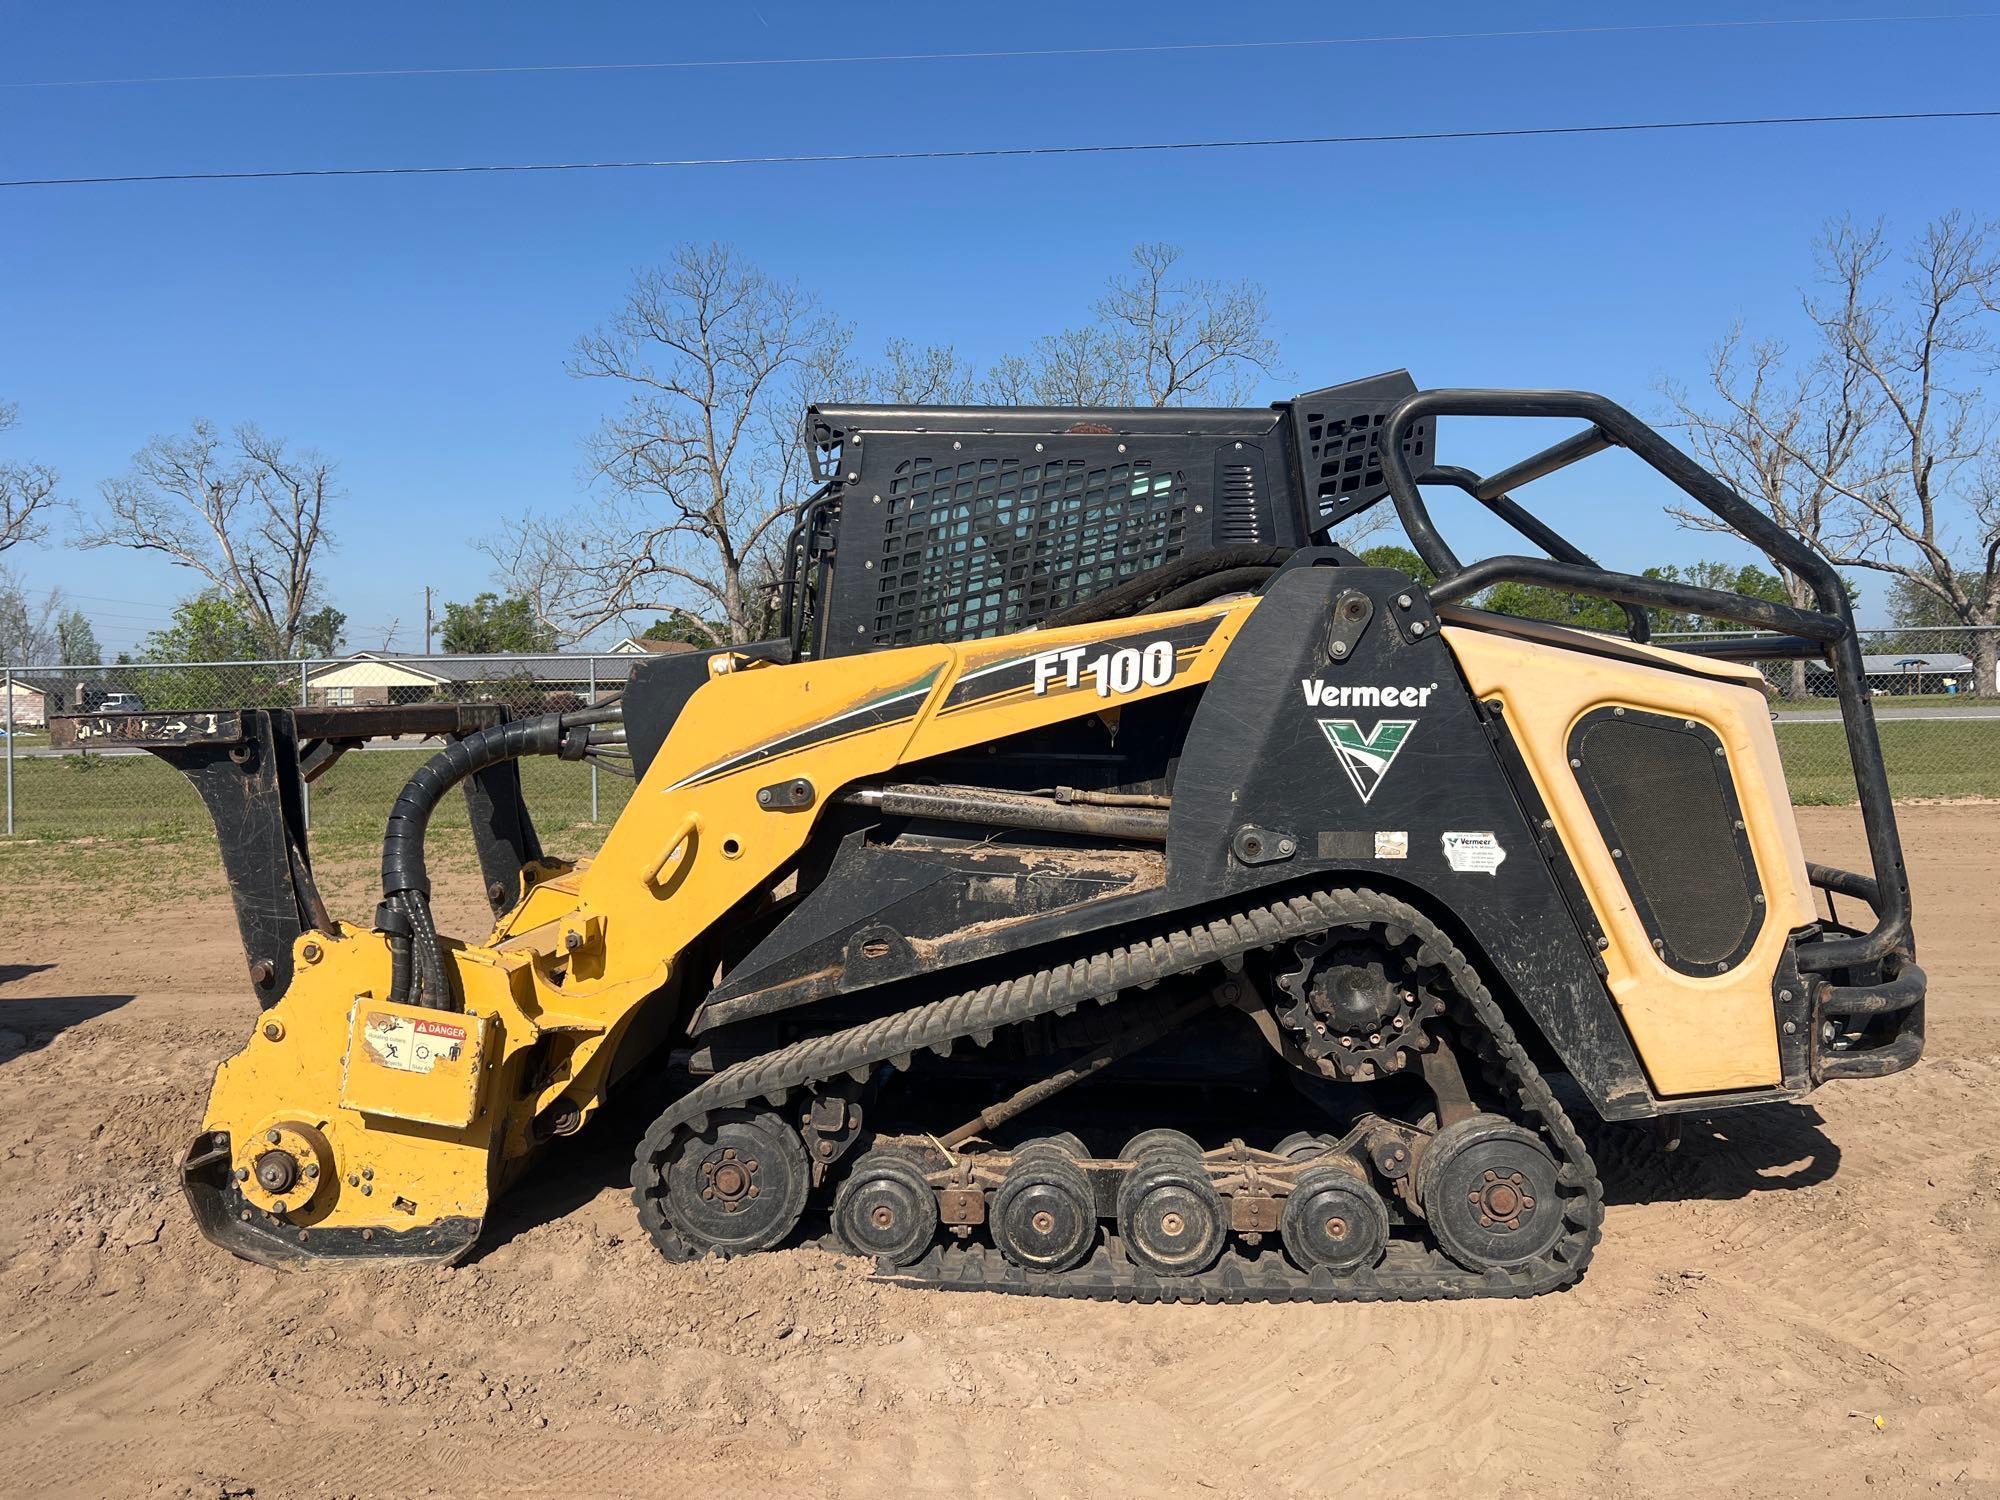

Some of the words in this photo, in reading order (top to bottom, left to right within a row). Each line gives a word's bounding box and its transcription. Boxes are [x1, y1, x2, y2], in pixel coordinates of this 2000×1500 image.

[1301, 679, 1432, 707] Vermeer
[1460, 837, 1491, 845] Vermeer
[428, 1024, 465, 1038] DANGER
